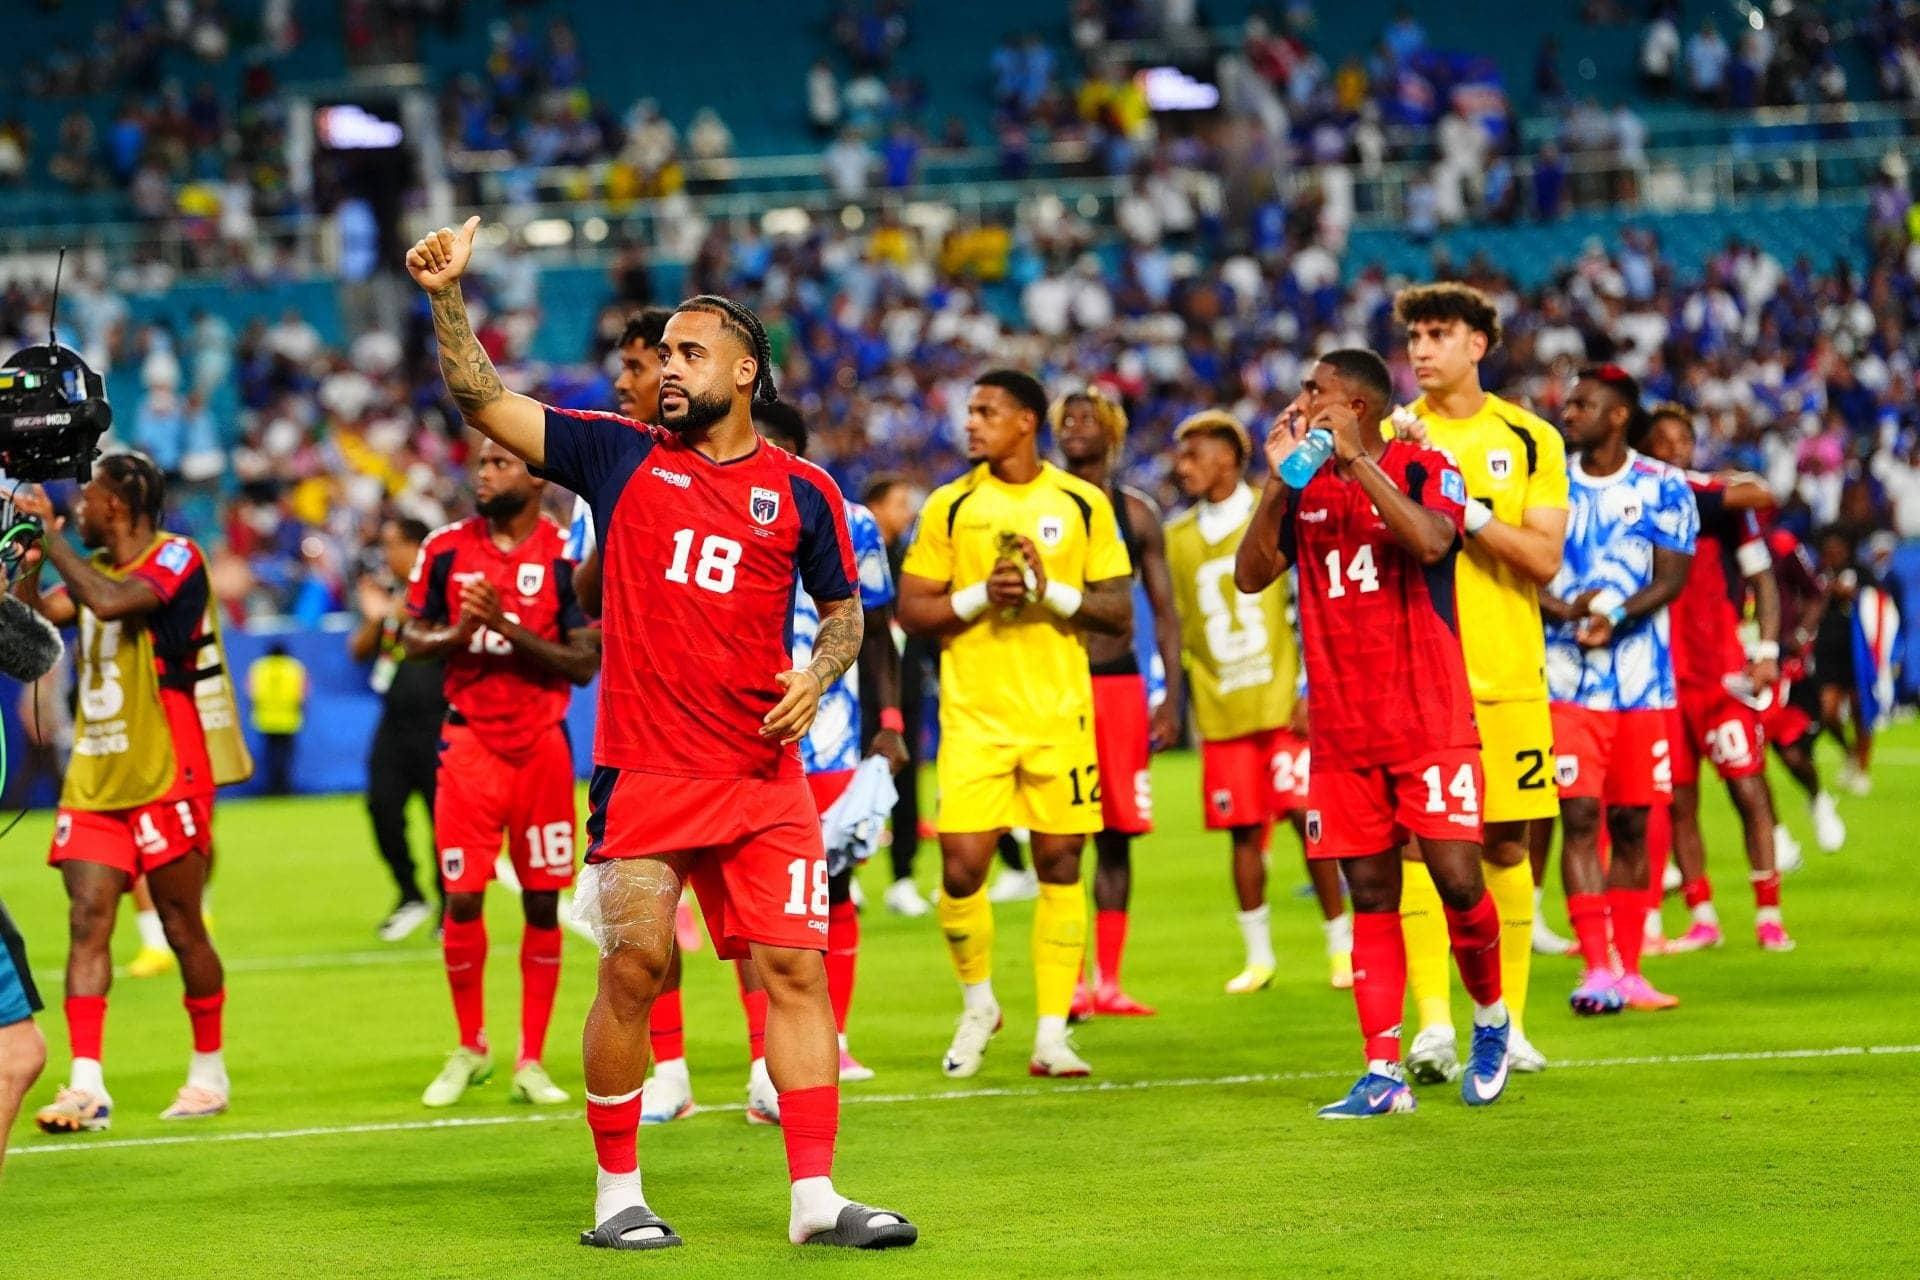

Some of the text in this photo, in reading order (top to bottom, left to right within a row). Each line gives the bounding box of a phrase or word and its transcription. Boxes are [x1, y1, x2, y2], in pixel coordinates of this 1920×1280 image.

[651, 466, 692, 489] capelli
[665, 528, 742, 594] 18
[1324, 544, 1380, 599] 14
[1422, 763, 1478, 813] 14
[525, 820, 573, 869] 16
[783, 858, 830, 916] 18
